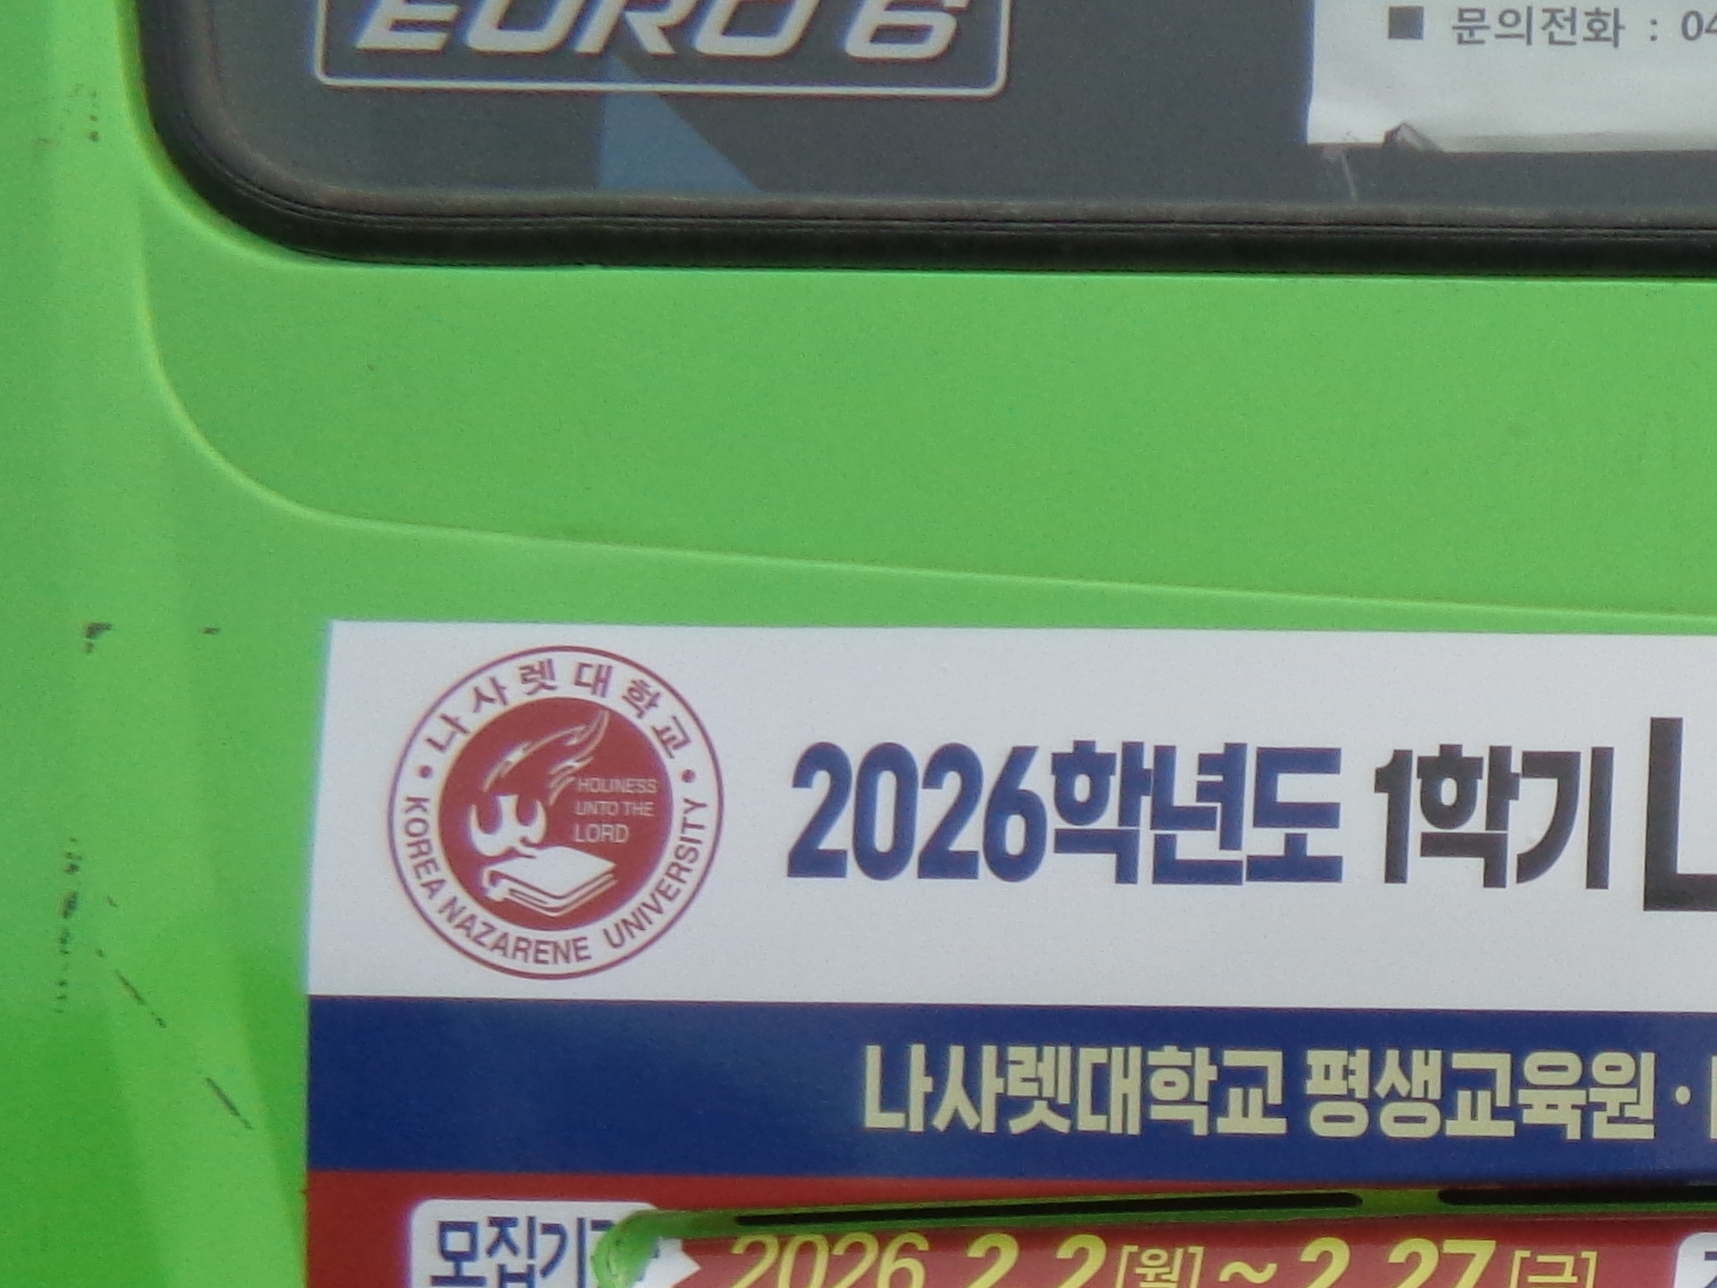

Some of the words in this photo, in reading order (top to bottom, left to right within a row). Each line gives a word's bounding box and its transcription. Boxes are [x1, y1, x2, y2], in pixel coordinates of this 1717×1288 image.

[355, 0, 812, 56] EURO
[844, 0, 970, 59] 6
[1452, 5, 1626, 48] 문의전화
[426, 658, 691, 758] 나사렛대학교
[576, 801, 618, 815] UNTO
[621, 801, 655, 817] THE
[577, 777, 657, 794] HOLINESS
[787, 739, 1343, 886] 2026학년도
[1374, 743, 1614, 889] 1학기
[574, 823, 630, 844] LORD
[405, 796, 445, 899] KOREA
[439, 896, 592, 965] NAZARENE
[603, 797, 707, 950] UNIVERSITY
[864, 1044, 1288, 1136] 나사렛대학교
